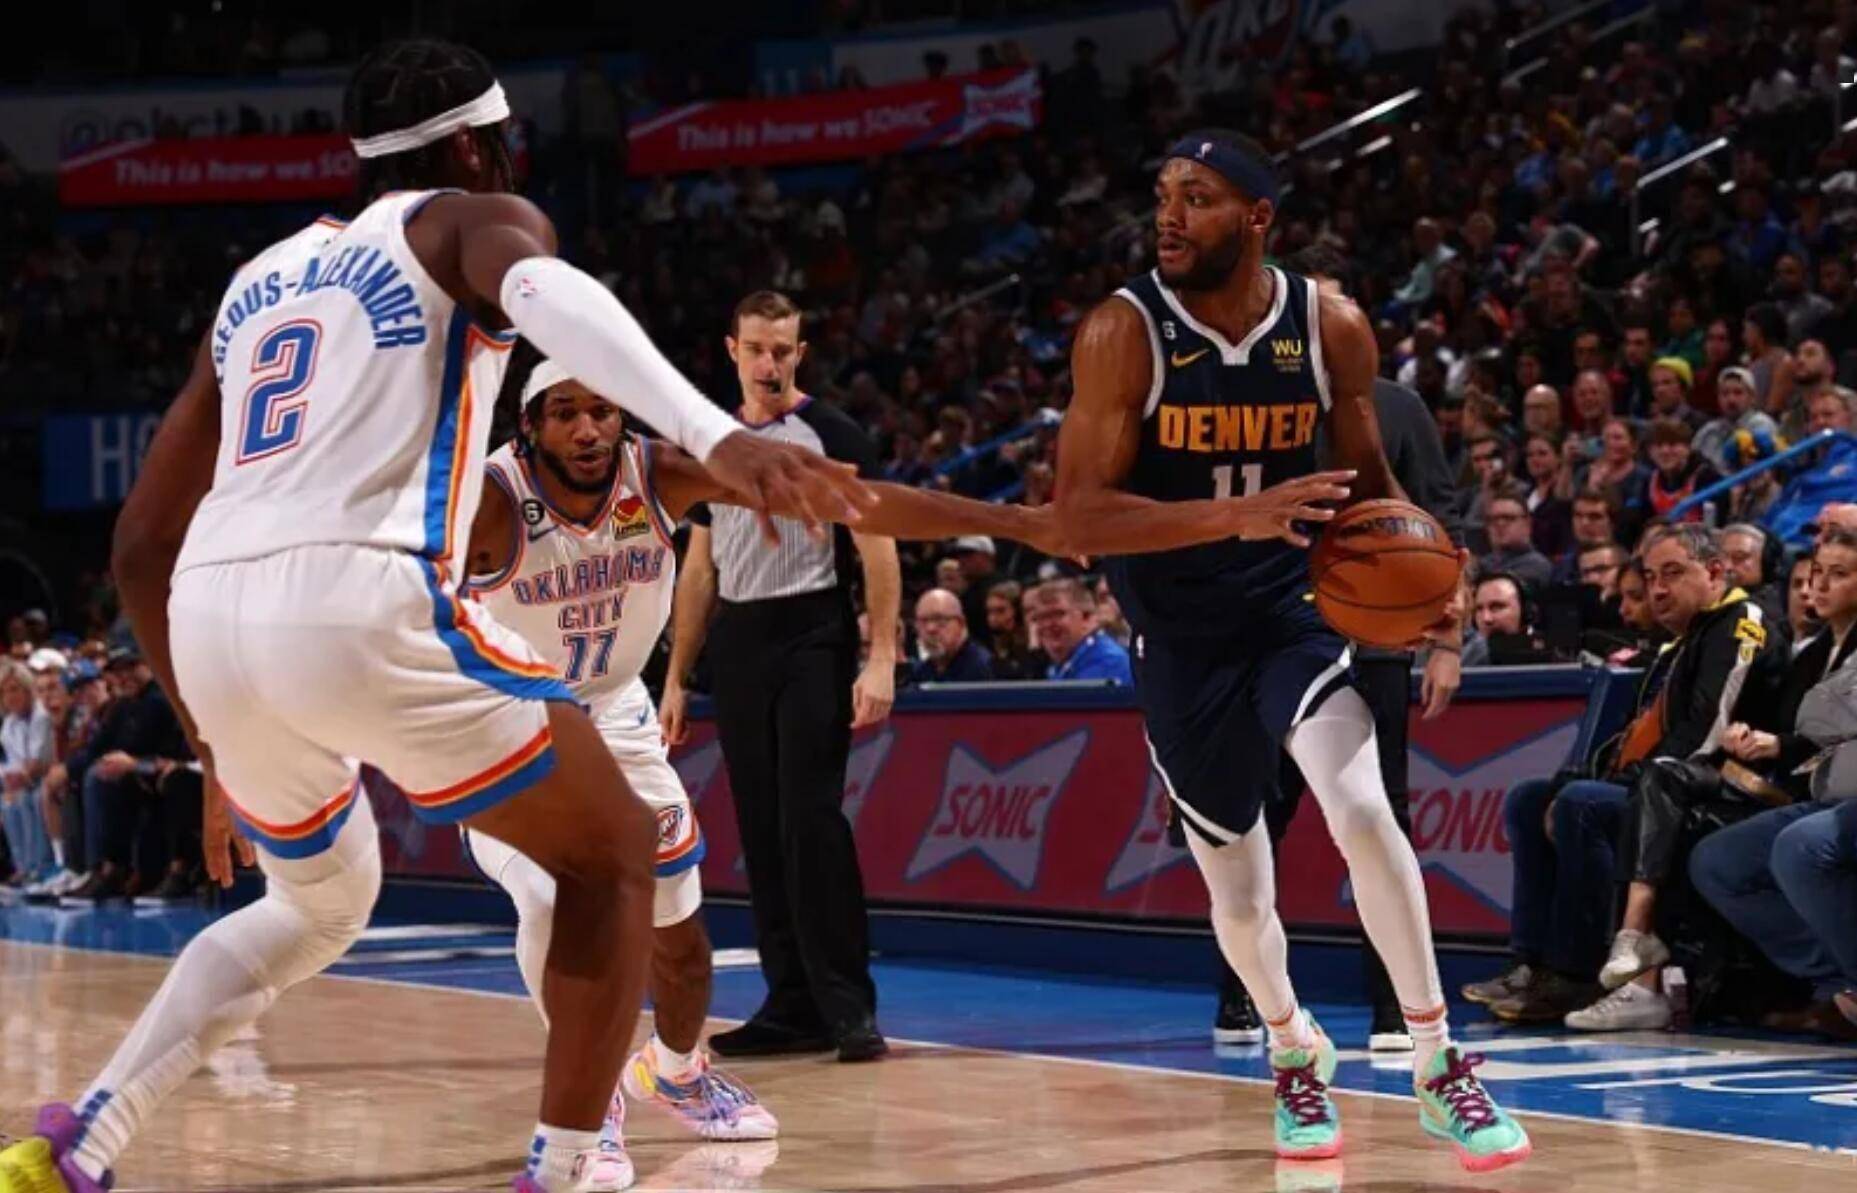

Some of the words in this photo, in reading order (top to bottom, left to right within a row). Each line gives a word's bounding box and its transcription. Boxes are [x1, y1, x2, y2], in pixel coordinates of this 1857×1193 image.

[677, 121, 729, 150] This
[732, 119, 756, 148] is
[759, 116, 818, 145] how
[822, 119, 859, 139] we
[863, 101, 936, 137] SONIC
[114, 158, 170, 187] This
[174, 156, 202, 183] is
[206, 158, 268, 182] how
[272, 160, 313, 181] we
[1270, 339, 1302, 358] WU
[235, 318, 323, 466] 2
[1158, 402, 1318, 453] DENVER
[1212, 463, 1264, 500] 11
[525, 500, 543, 524] 6
[511, 545, 665, 605] OKLAHOMA
[558, 592, 627, 631] CITY
[562, 626, 620, 684] 77
[934, 784, 1052, 841] SONIC
